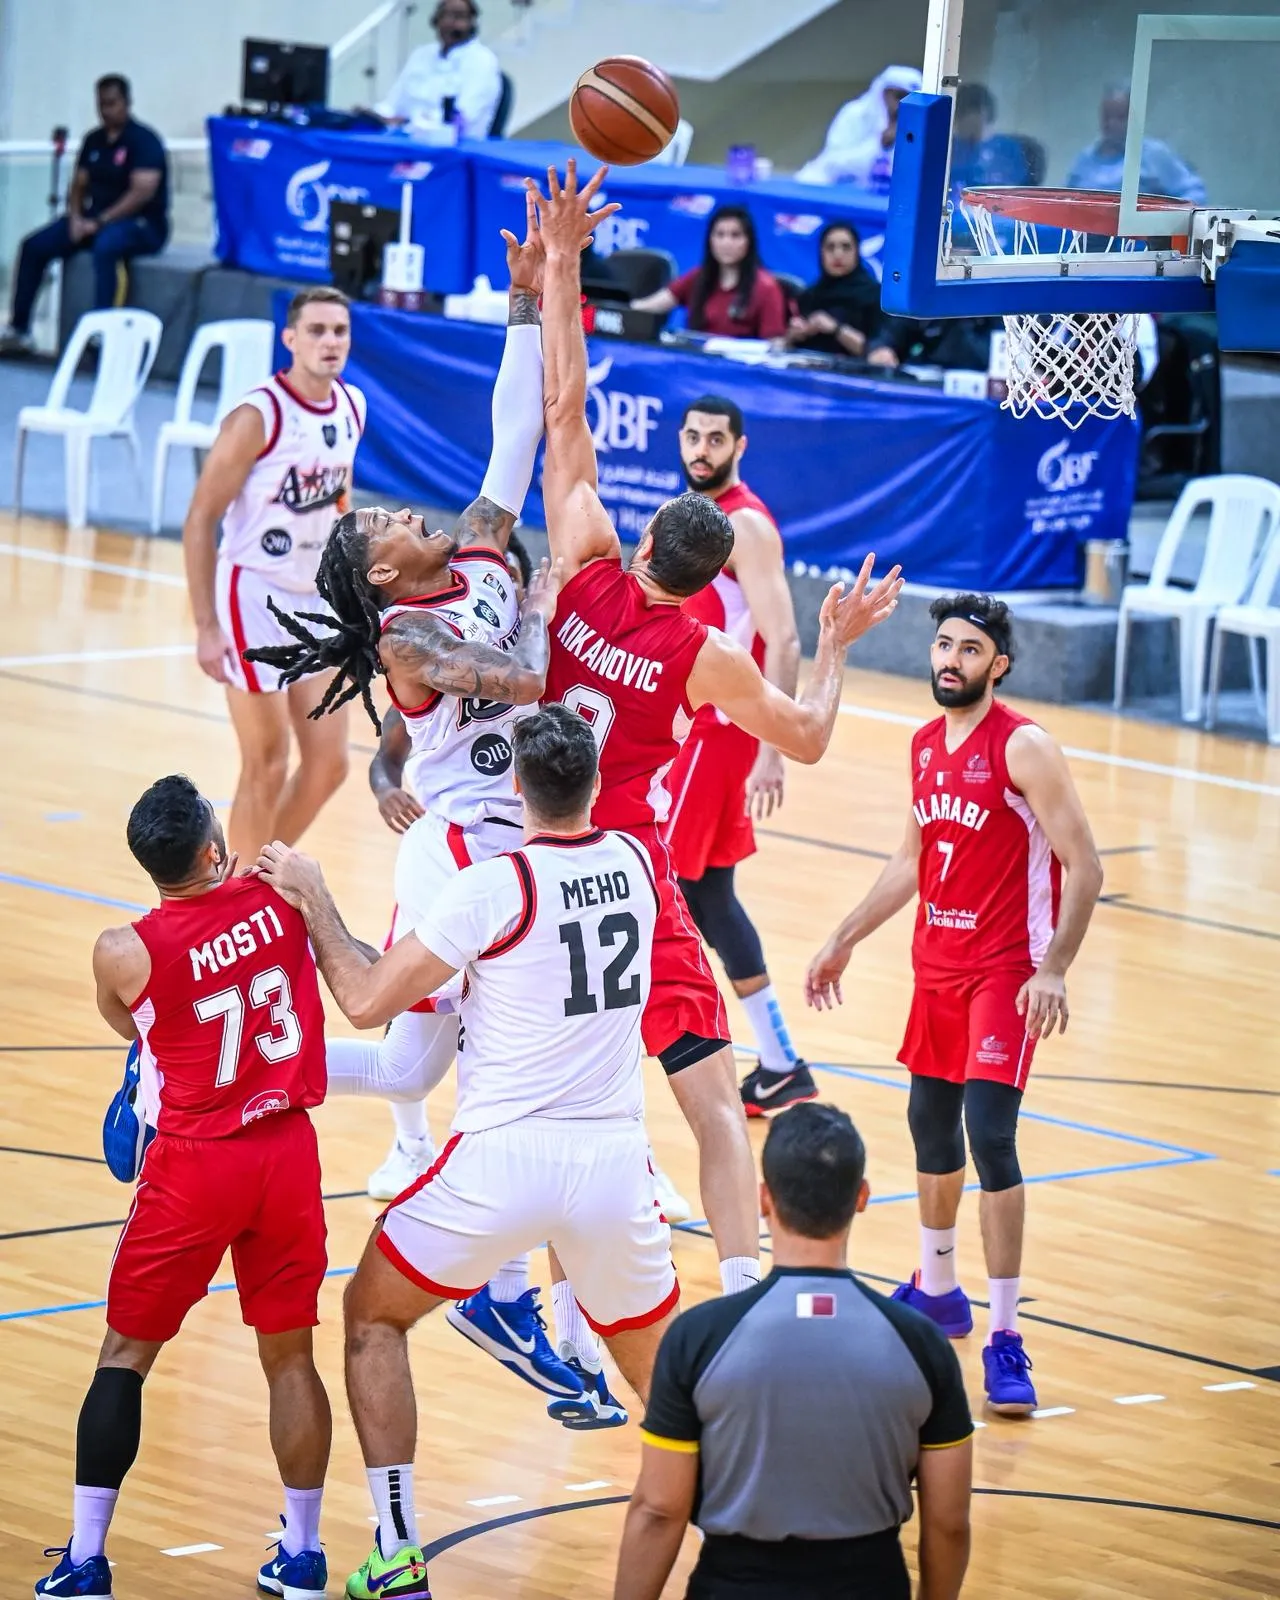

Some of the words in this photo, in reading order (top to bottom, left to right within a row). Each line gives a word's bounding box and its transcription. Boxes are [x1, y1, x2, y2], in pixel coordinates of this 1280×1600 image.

[1037, 437, 1099, 492] QBF
[556, 611, 663, 693] KIKANOVIC
[474, 742, 510, 769] QIB
[560, 870, 631, 910] MEHO
[937, 841, 954, 881] 7
[189, 905, 284, 982] MOSTI
[559, 911, 641, 1017] 12
[193, 964, 303, 1089] 73
